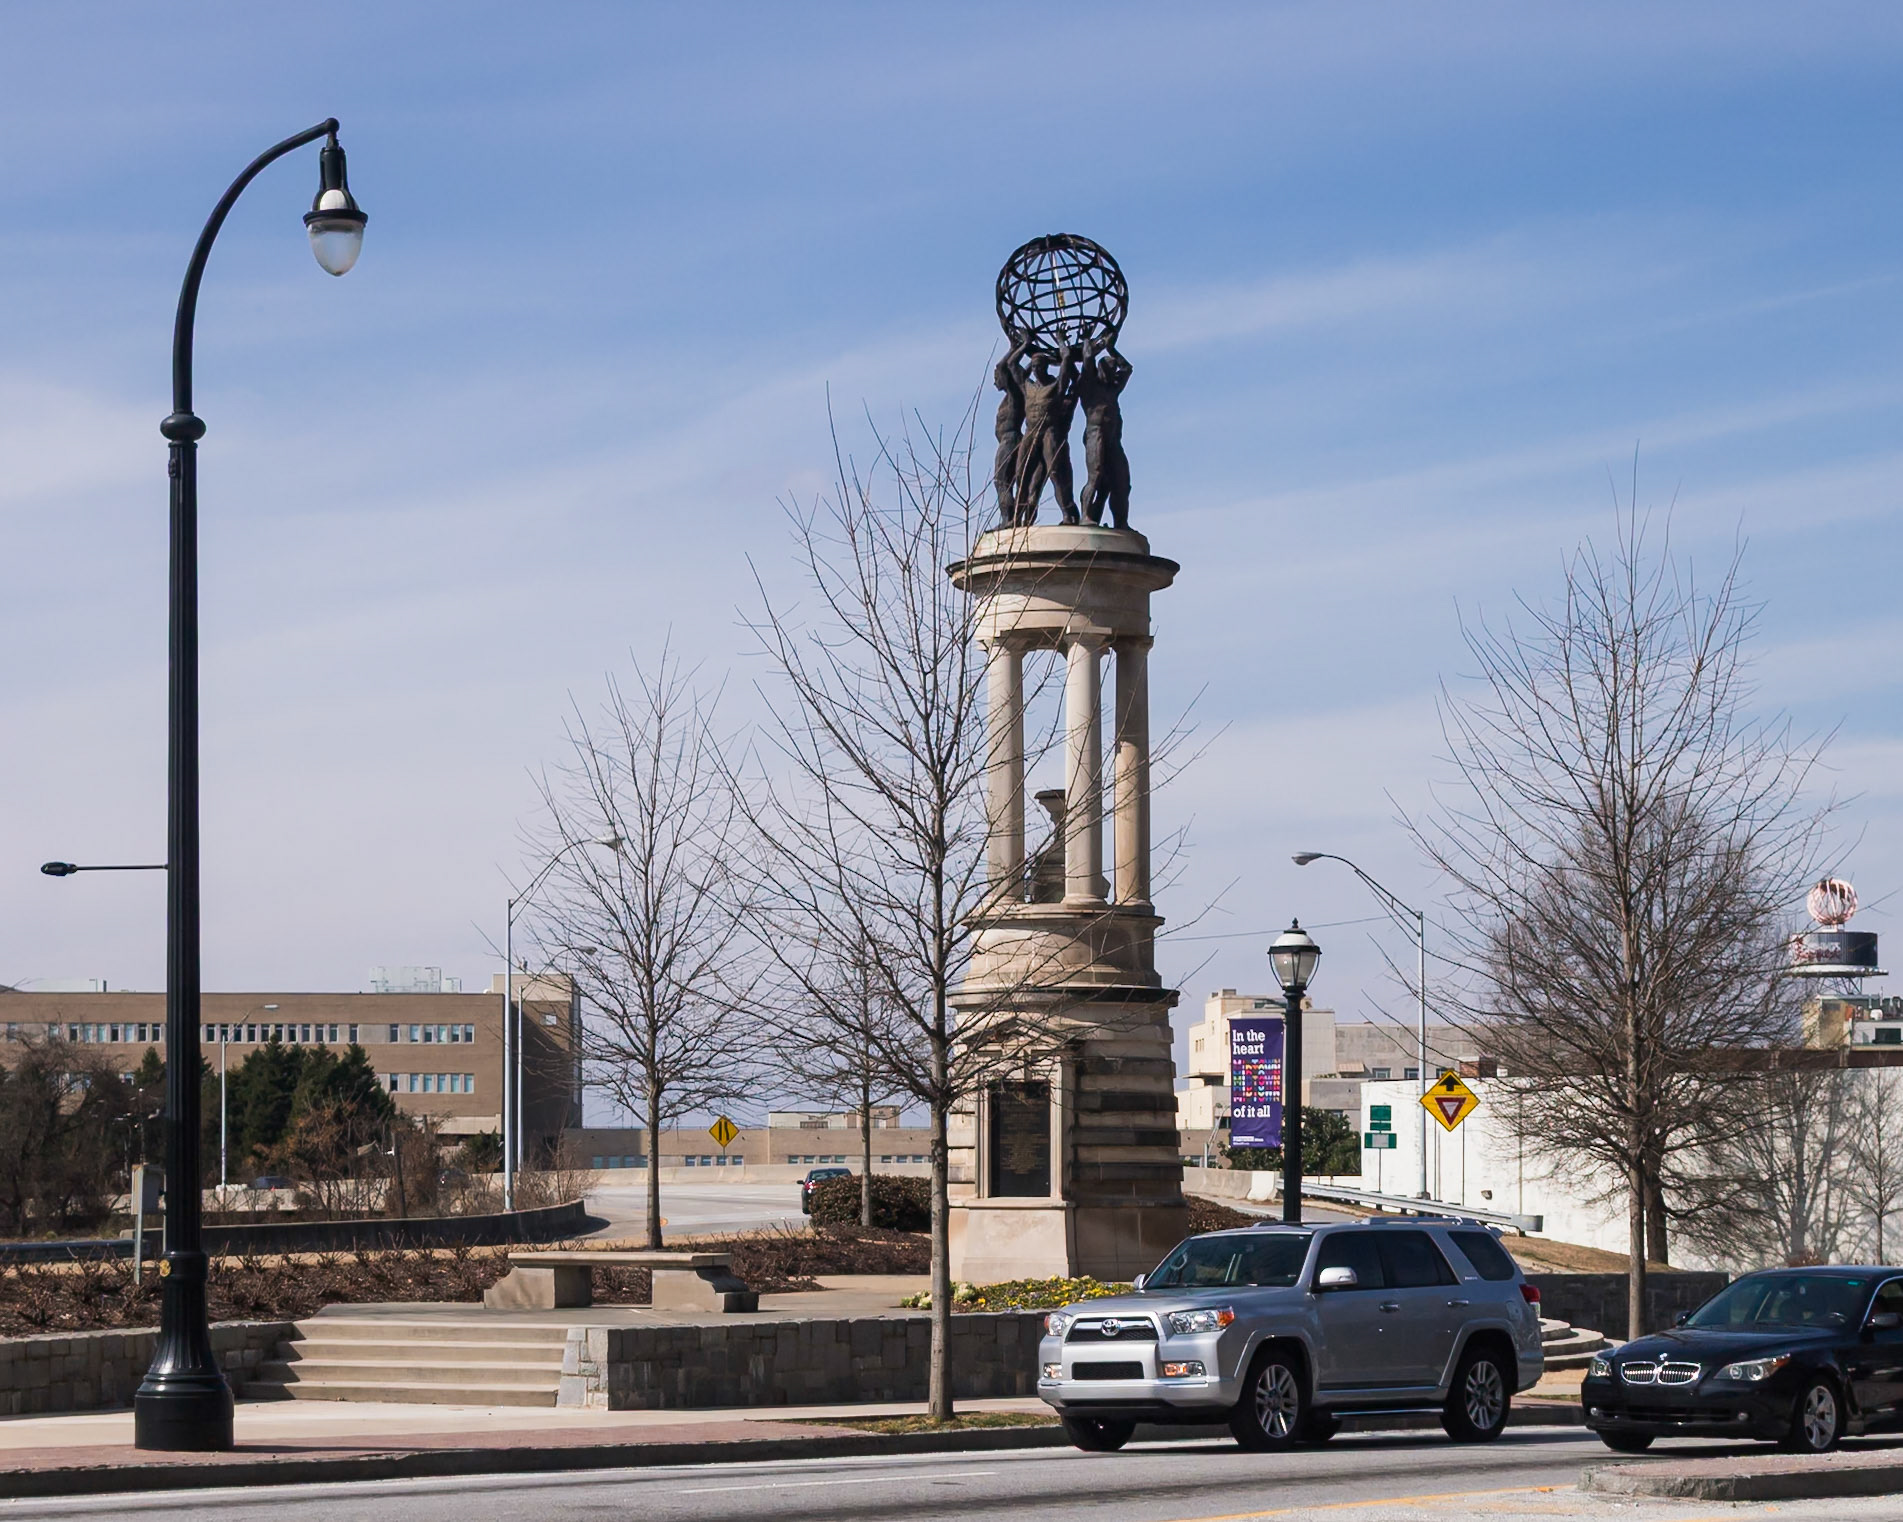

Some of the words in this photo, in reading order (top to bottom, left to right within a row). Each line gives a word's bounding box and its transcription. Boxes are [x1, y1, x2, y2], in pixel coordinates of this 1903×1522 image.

[1232, 1029, 1244, 1042] In
[1247, 1029, 1265, 1042] the
[1232, 1042, 1264, 1055] heart
[1233, 1105, 1246, 1118] of
[1247, 1105, 1255, 1118] it
[1256, 1105, 1270, 1118] all
